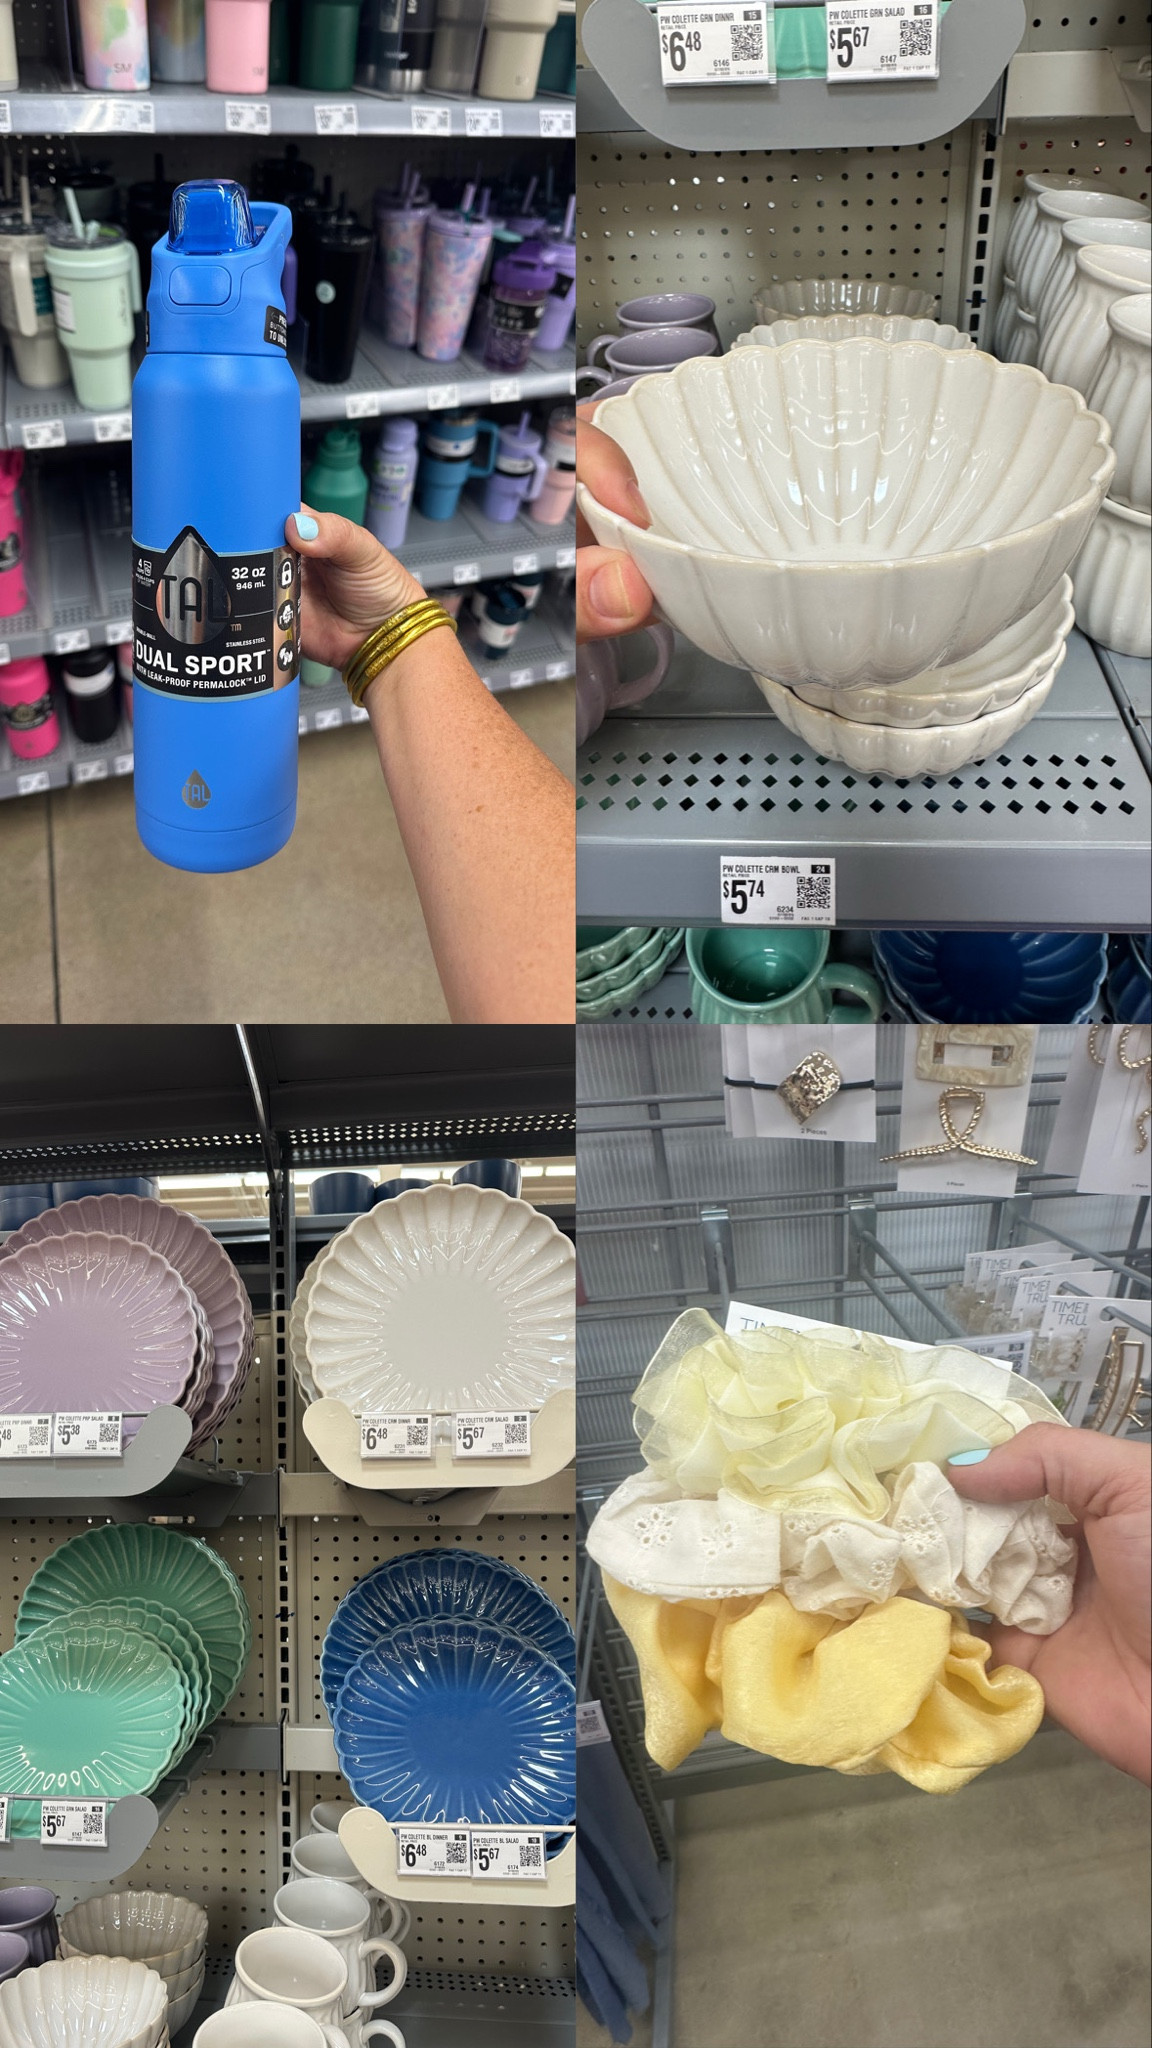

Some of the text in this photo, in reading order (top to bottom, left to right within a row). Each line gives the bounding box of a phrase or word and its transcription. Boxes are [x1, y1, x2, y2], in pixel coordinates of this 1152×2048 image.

[748, 11, 757, 19] 15
[829, 7, 905, 20] PW COLETTE GRN SALAD
[919, 6, 928, 14] 16
[660, 13, 735, 24] PW COLETTE GRN DINNR
[880, 55, 897, 63] 6147
[270, 330, 278, 340] TO
[231, 567, 266, 580] 32 oz
[236, 580, 266, 590] 946 mL
[161, 575, 230, 623] TAL
[225, 637, 266, 648] STAINLESS STEEL
[136, 639, 179, 672] DUAL
[147, 670, 191, 688] LEAK-PROOF
[254, 674, 267, 685] LID
[184, 783, 211, 801] TAL
[722, 864, 801, 874] PW COLETTE CRM BOWL
[1051, 1300, 1085, 1314] TIME
